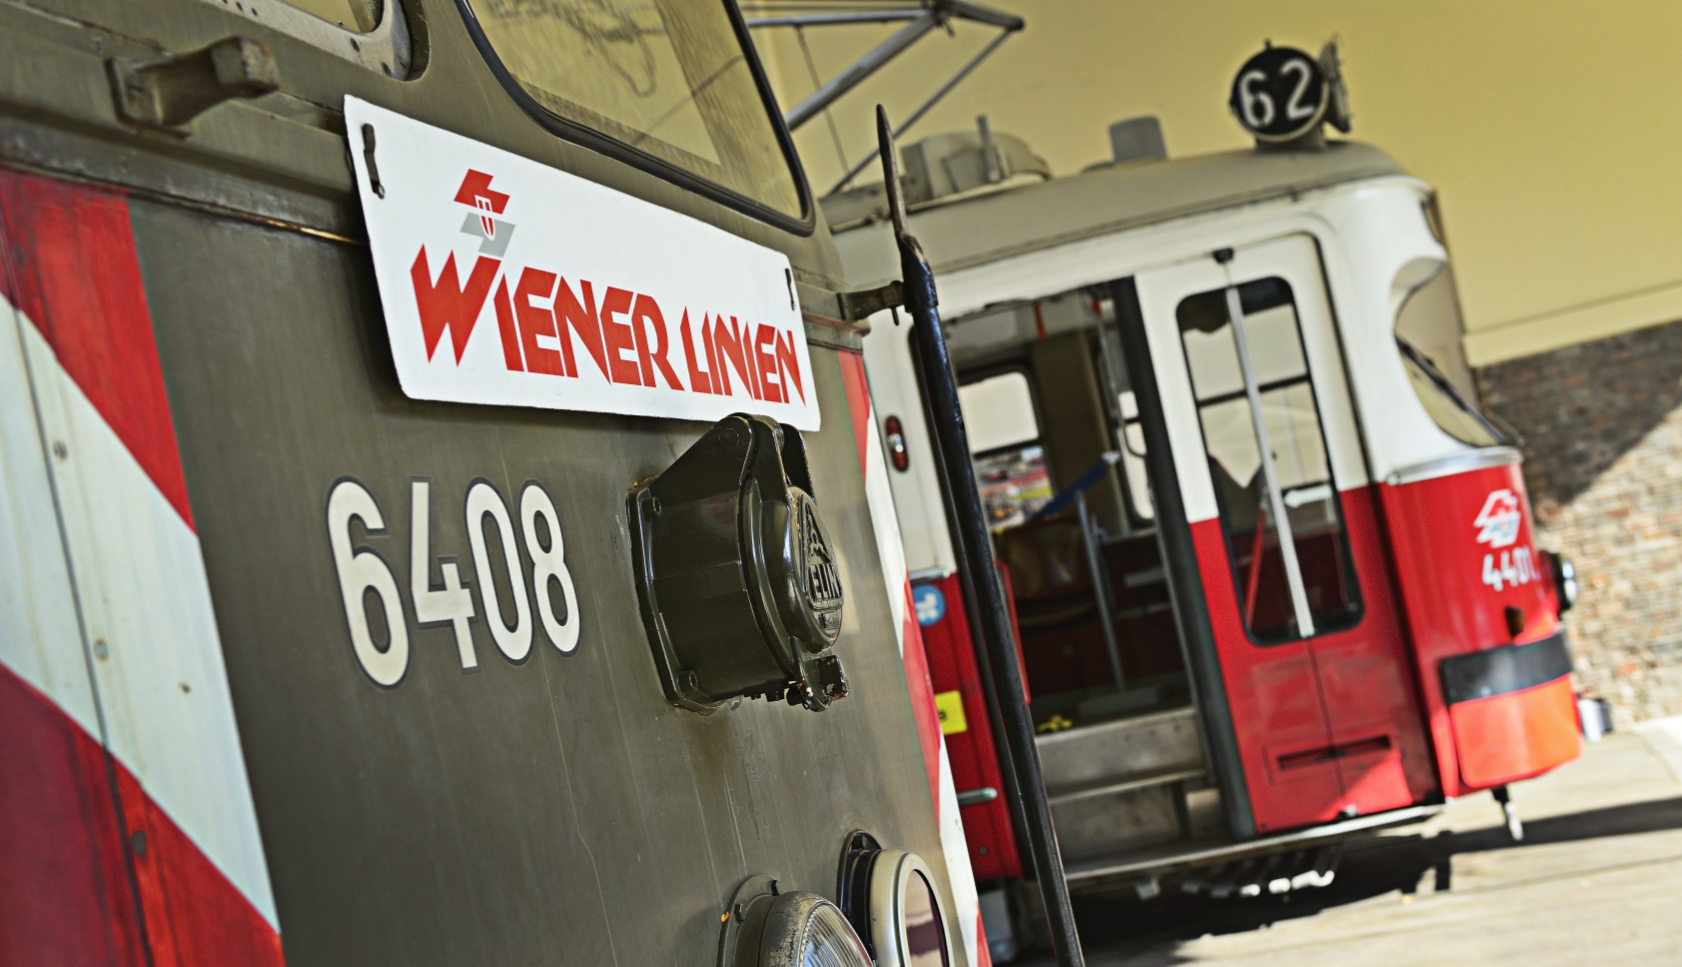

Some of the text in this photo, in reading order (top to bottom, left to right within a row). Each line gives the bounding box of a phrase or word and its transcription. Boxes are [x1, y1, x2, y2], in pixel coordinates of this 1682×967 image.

[1239, 58, 1316, 128] 62
[410, 243, 807, 408] WIENER LINIEN
[327, 478, 581, 688] 6408
